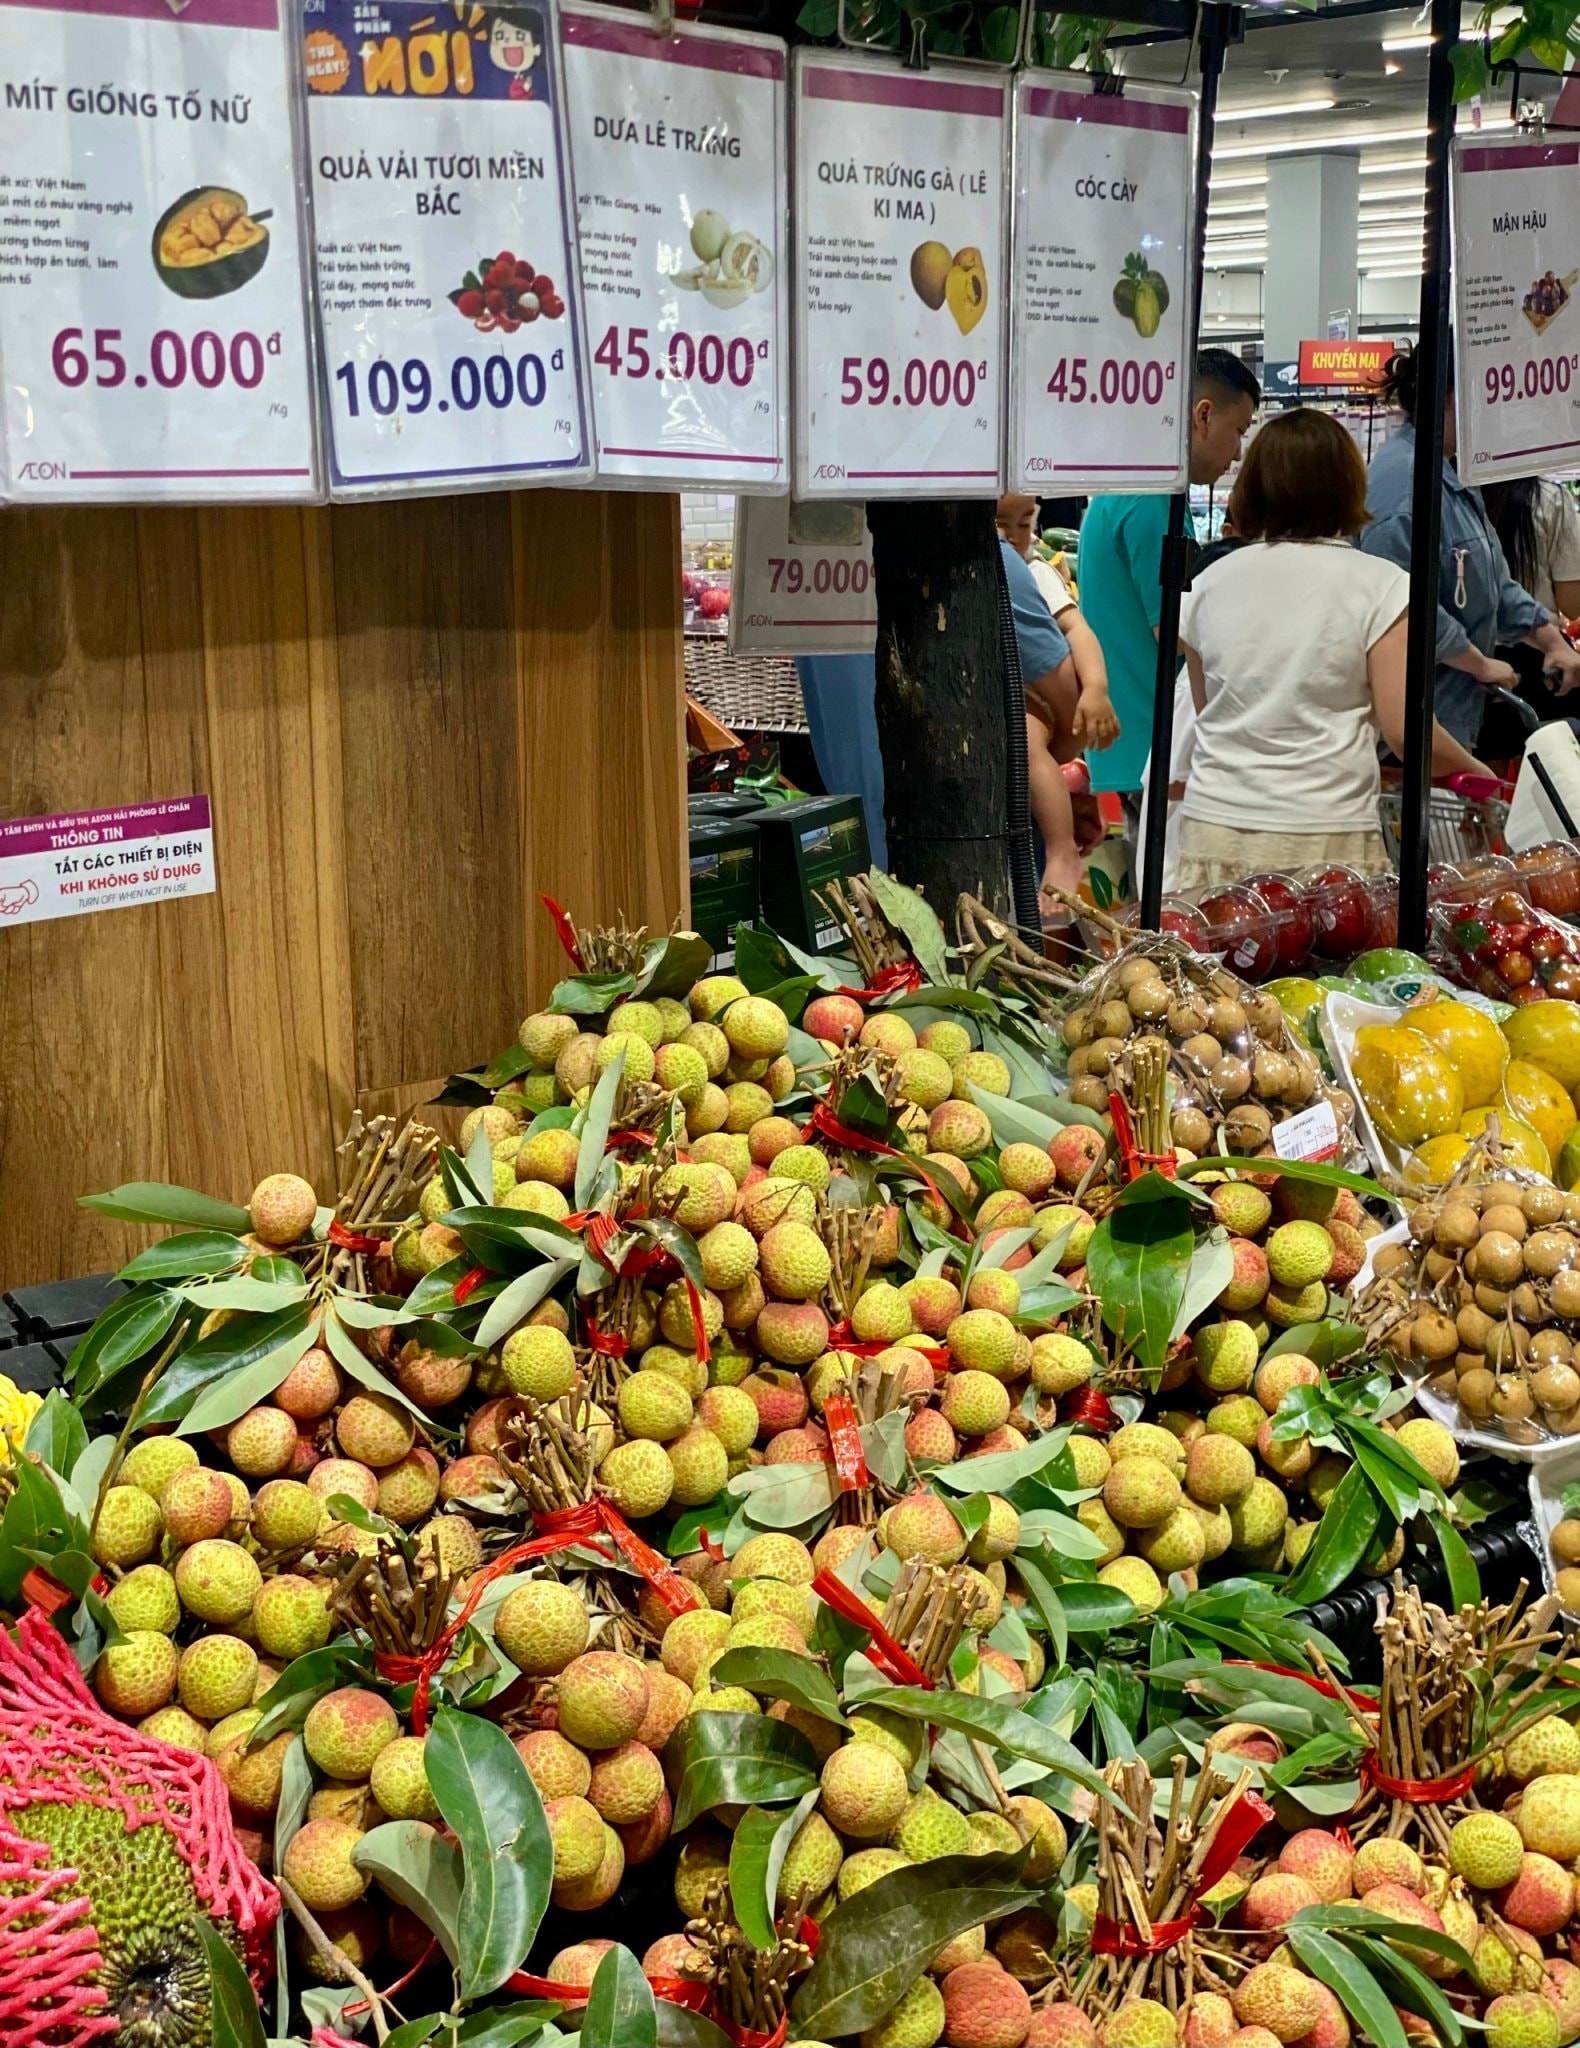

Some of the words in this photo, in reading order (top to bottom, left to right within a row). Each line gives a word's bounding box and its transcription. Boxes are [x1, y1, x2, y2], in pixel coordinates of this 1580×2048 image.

[363, 16, 474, 95] MỚI
[5, 77, 57, 111] MÍT
[67, 82, 158, 117] GIỐNG
[165, 89, 201, 120] TỐ
[211, 94, 251, 124] NỮ
[594, 116, 639, 144] DƯA
[646, 120, 666, 147] LÊ
[319, 150, 372, 182] QUẢ
[378, 150, 417, 179] VẢI
[424, 153, 481, 179] TƯƠI
[488, 150, 544, 180] MIỀN
[818, 158, 858, 184] QUẢ
[864, 162, 926, 189] TRỨNG
[930, 167, 954, 192] GÀ
[970, 170, 987, 193] LÊ
[36, 178, 57, 190] Việt
[61, 180, 86, 190] Nam
[1075, 174, 1106, 199] CÓC
[1111, 177, 1138, 202] CÀY
[416, 184, 462, 215] BẮC
[874, 198, 890, 218] KI
[896, 200, 925, 220] MA
[1493, 212, 1519, 236] MẬN
[1523, 210, 1546, 233] HẬU
[614, 232, 636, 247] trắng
[841, 238, 856, 248] Việt
[858, 239, 875, 248] Nam
[358, 243, 376, 255] Việt
[379, 243, 402, 252] Nam
[585, 248, 608, 260] mọng
[338, 262, 357, 272] tròn
[360, 260, 381, 271] hình
[384, 260, 410, 274] trứng
[880, 257, 897, 266] xanh
[591, 265, 614, 275] thanh
[824, 270, 842, 279] xanh
[876, 272, 892, 282] theo
[601, 282, 615, 293] đặc
[618, 285, 640, 298] trưng
[334, 300, 356, 311] ngọt
[358, 299, 383, 308] thơm
[386, 298, 402, 309] đặc
[405, 298, 431, 309] trưng
[1312, 347, 1357, 369] KHUYẾN
[1359, 352, 1380, 372] MẠI
[268, 403, 288, 418] /Kg
[754, 400, 769, 413] /Kg
[554, 419, 571, 433] /Kg
[974, 418, 987, 430] /Kg
[1161, 415, 1174, 427] /Kg
[4, 825, 21, 836] TÂM
[24, 823, 44, 833] BHTH
[77, 817, 89, 827] THỊ
[91, 814, 112, 824] AEON
[114, 811, 127, 821] HẢI
[129, 807, 157, 819] PHÒNG
[158, 805, 166, 814] LÊ
[168, 803, 190, 813] CHÂN
[51, 829, 99, 848] THÔNG
[102, 826, 124, 840] TIN
[55, 856, 78, 875] TẮT
[83, 854, 114, 870] CÁC
[119, 844, 153, 865] THIẾT
[157, 847, 169, 861] BỊ
[173, 842, 203, 859] ĐIỆN
[60, 881, 83, 895] KHI
[88, 873, 139, 891] KHÔNG
[143, 865, 159, 881] SỬ
[163, 863, 201, 883] DỤNG
[79, 898, 99, 908] TURN
[100, 894, 118, 905] OFF
[119, 890, 143, 901] WHEN
[144, 887, 161, 897] NOT
[163, 885, 171, 893] IN
[171, 883, 188, 892] USE
